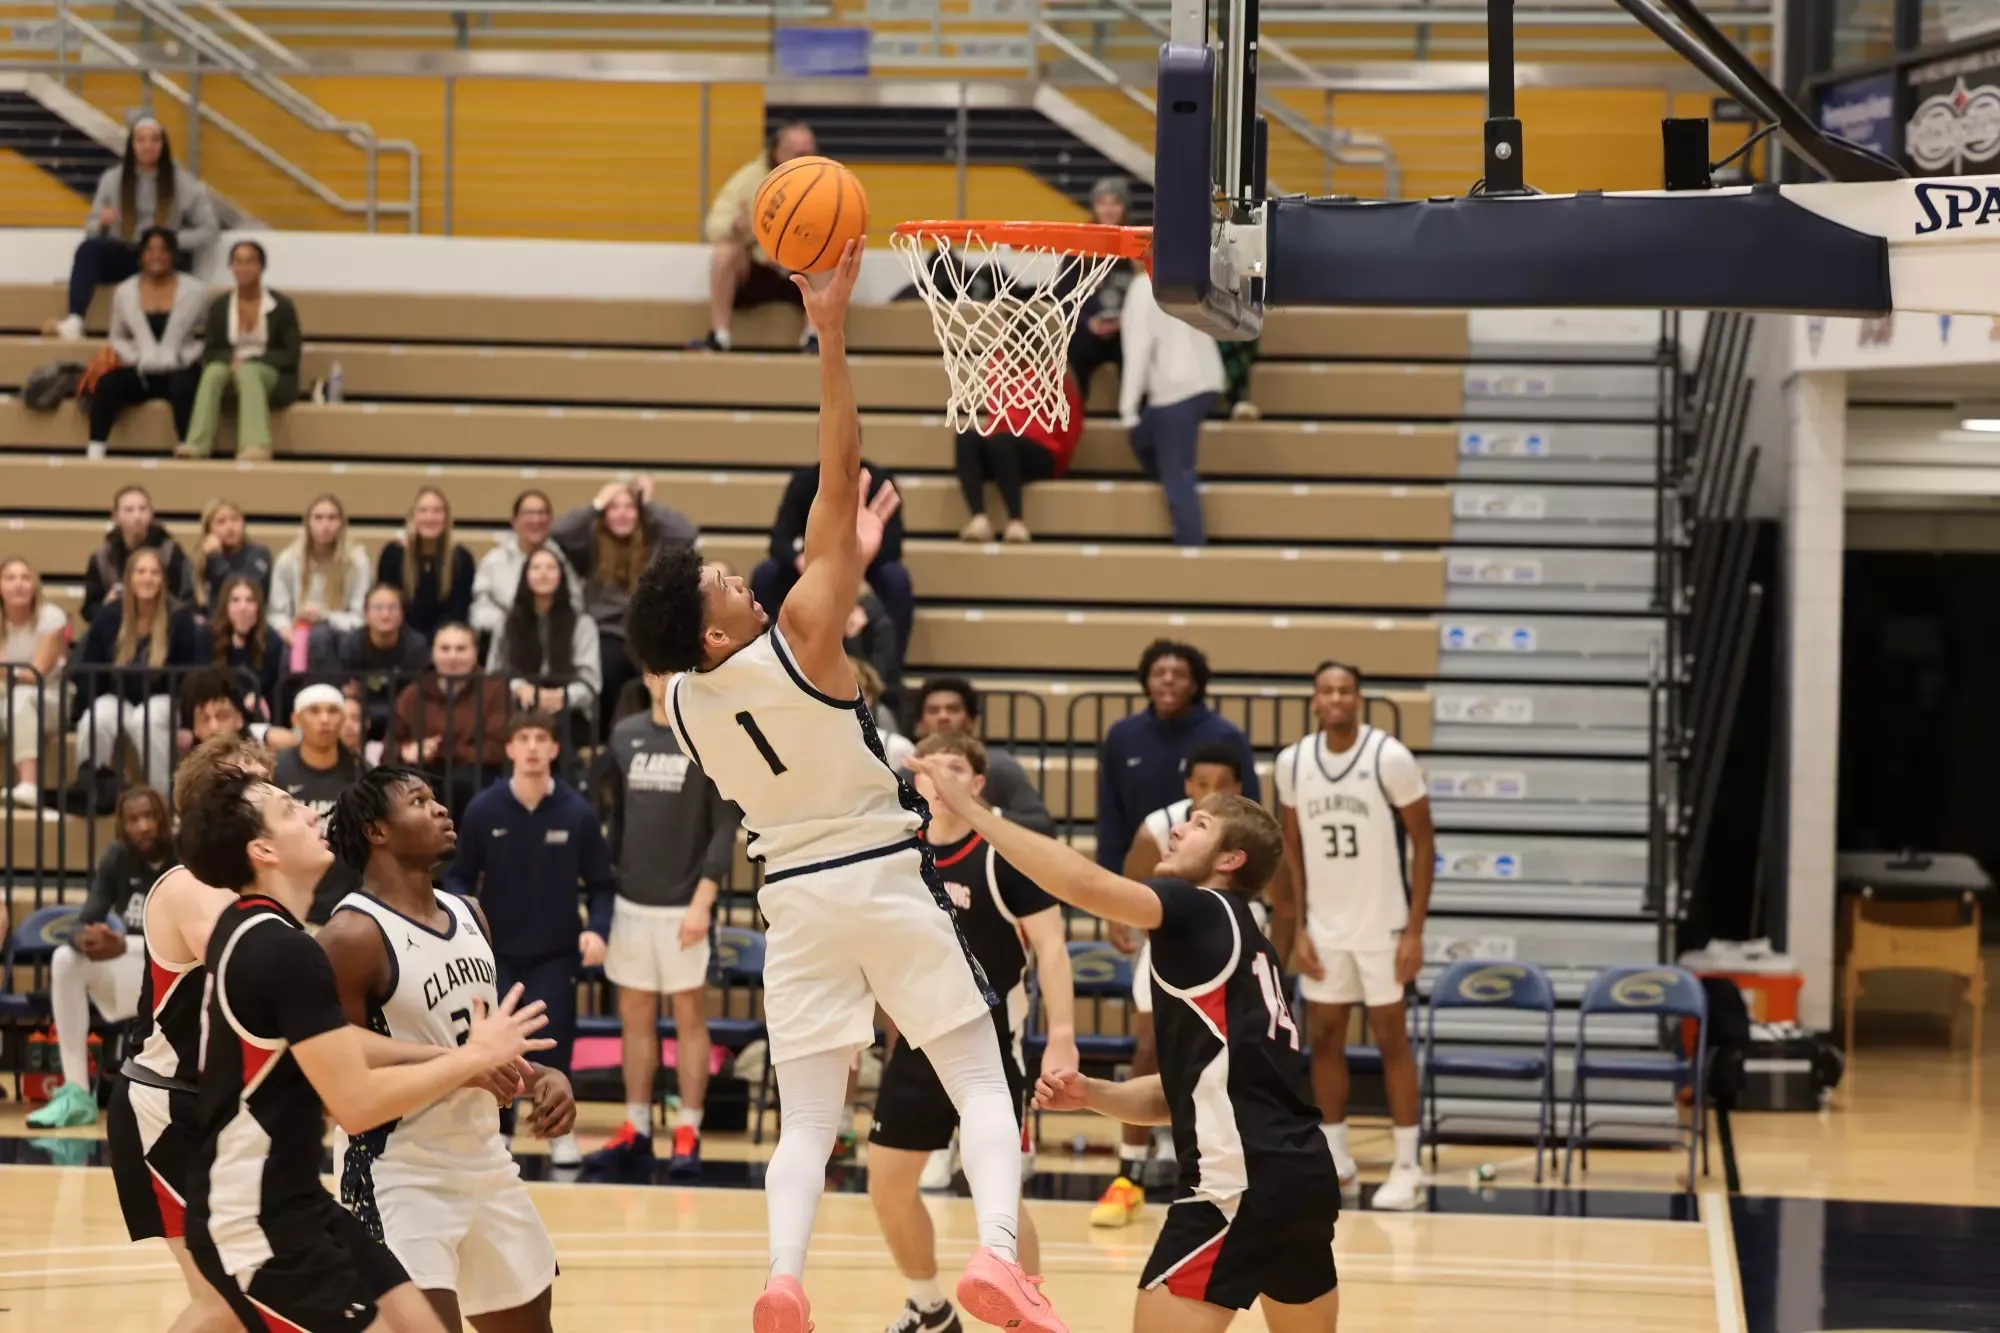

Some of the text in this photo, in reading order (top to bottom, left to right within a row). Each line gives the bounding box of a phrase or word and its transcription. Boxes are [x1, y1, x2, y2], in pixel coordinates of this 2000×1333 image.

[735, 710, 788, 776] 1
[1321, 824, 1359, 858] 33
[1251, 951, 1300, 1052] 14
